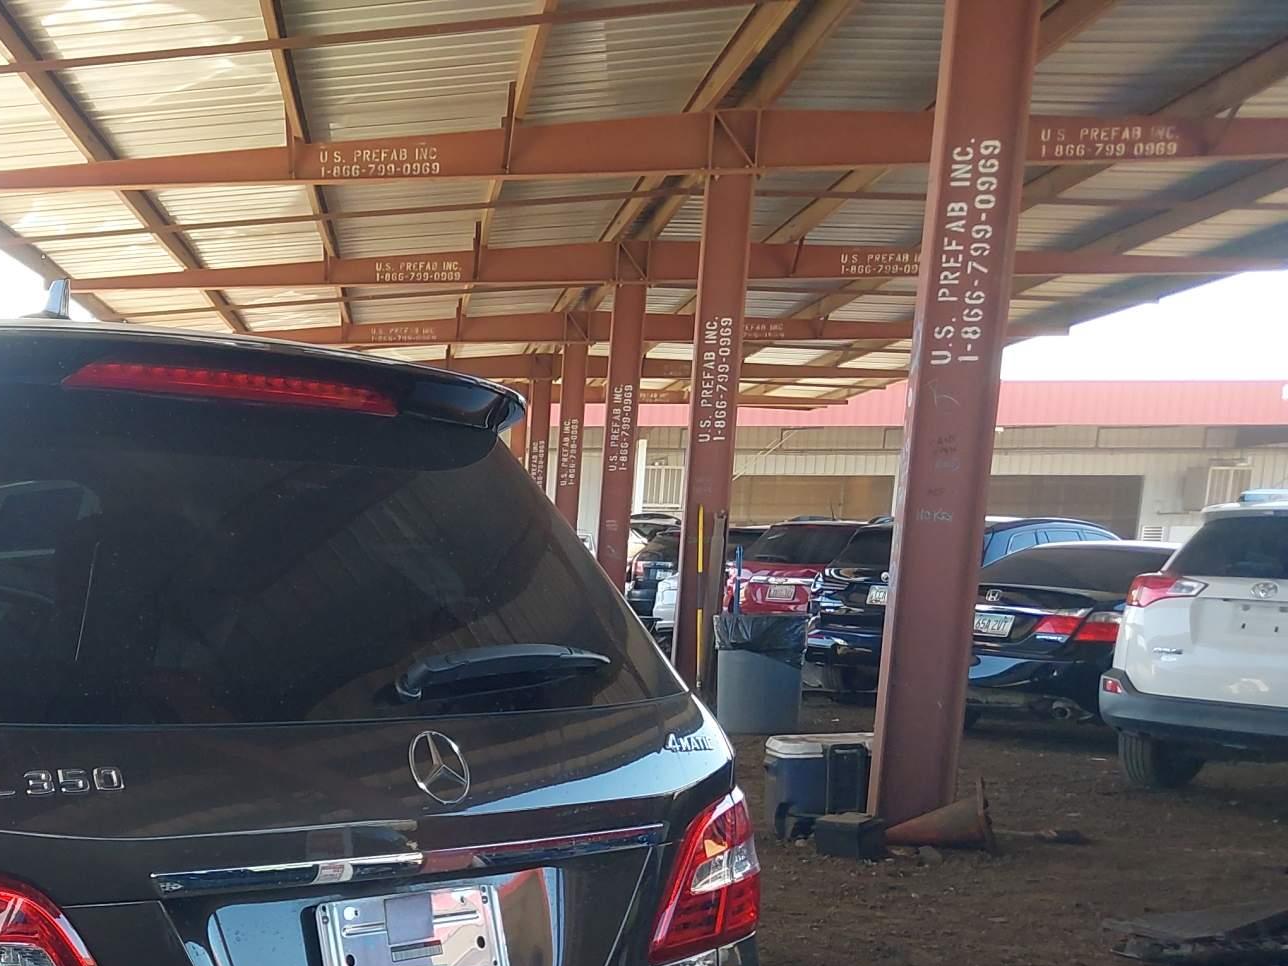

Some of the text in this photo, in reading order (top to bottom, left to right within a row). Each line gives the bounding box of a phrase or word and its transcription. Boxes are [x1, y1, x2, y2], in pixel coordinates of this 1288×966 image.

[1079, 126, 1142, 141] PREFAB
[353, 148, 408, 163] PREFAB
[1041, 142, 1178, 158] 1866-7990969
[320, 162, 441, 178] 1-866-799-0969
[931, 138, 976, 365] U.S. PREFAB INC.
[958, 139, 1002, 362] 1-866-799-0969
[613, 384, 624, 404] INC.
[698, 316, 719, 443] U.S. PREFAB INC.
[713, 317, 733, 441] 1-866-799-0969
[610, 408, 621, 447] PREFAB
[23, 766, 126, 796] 350
